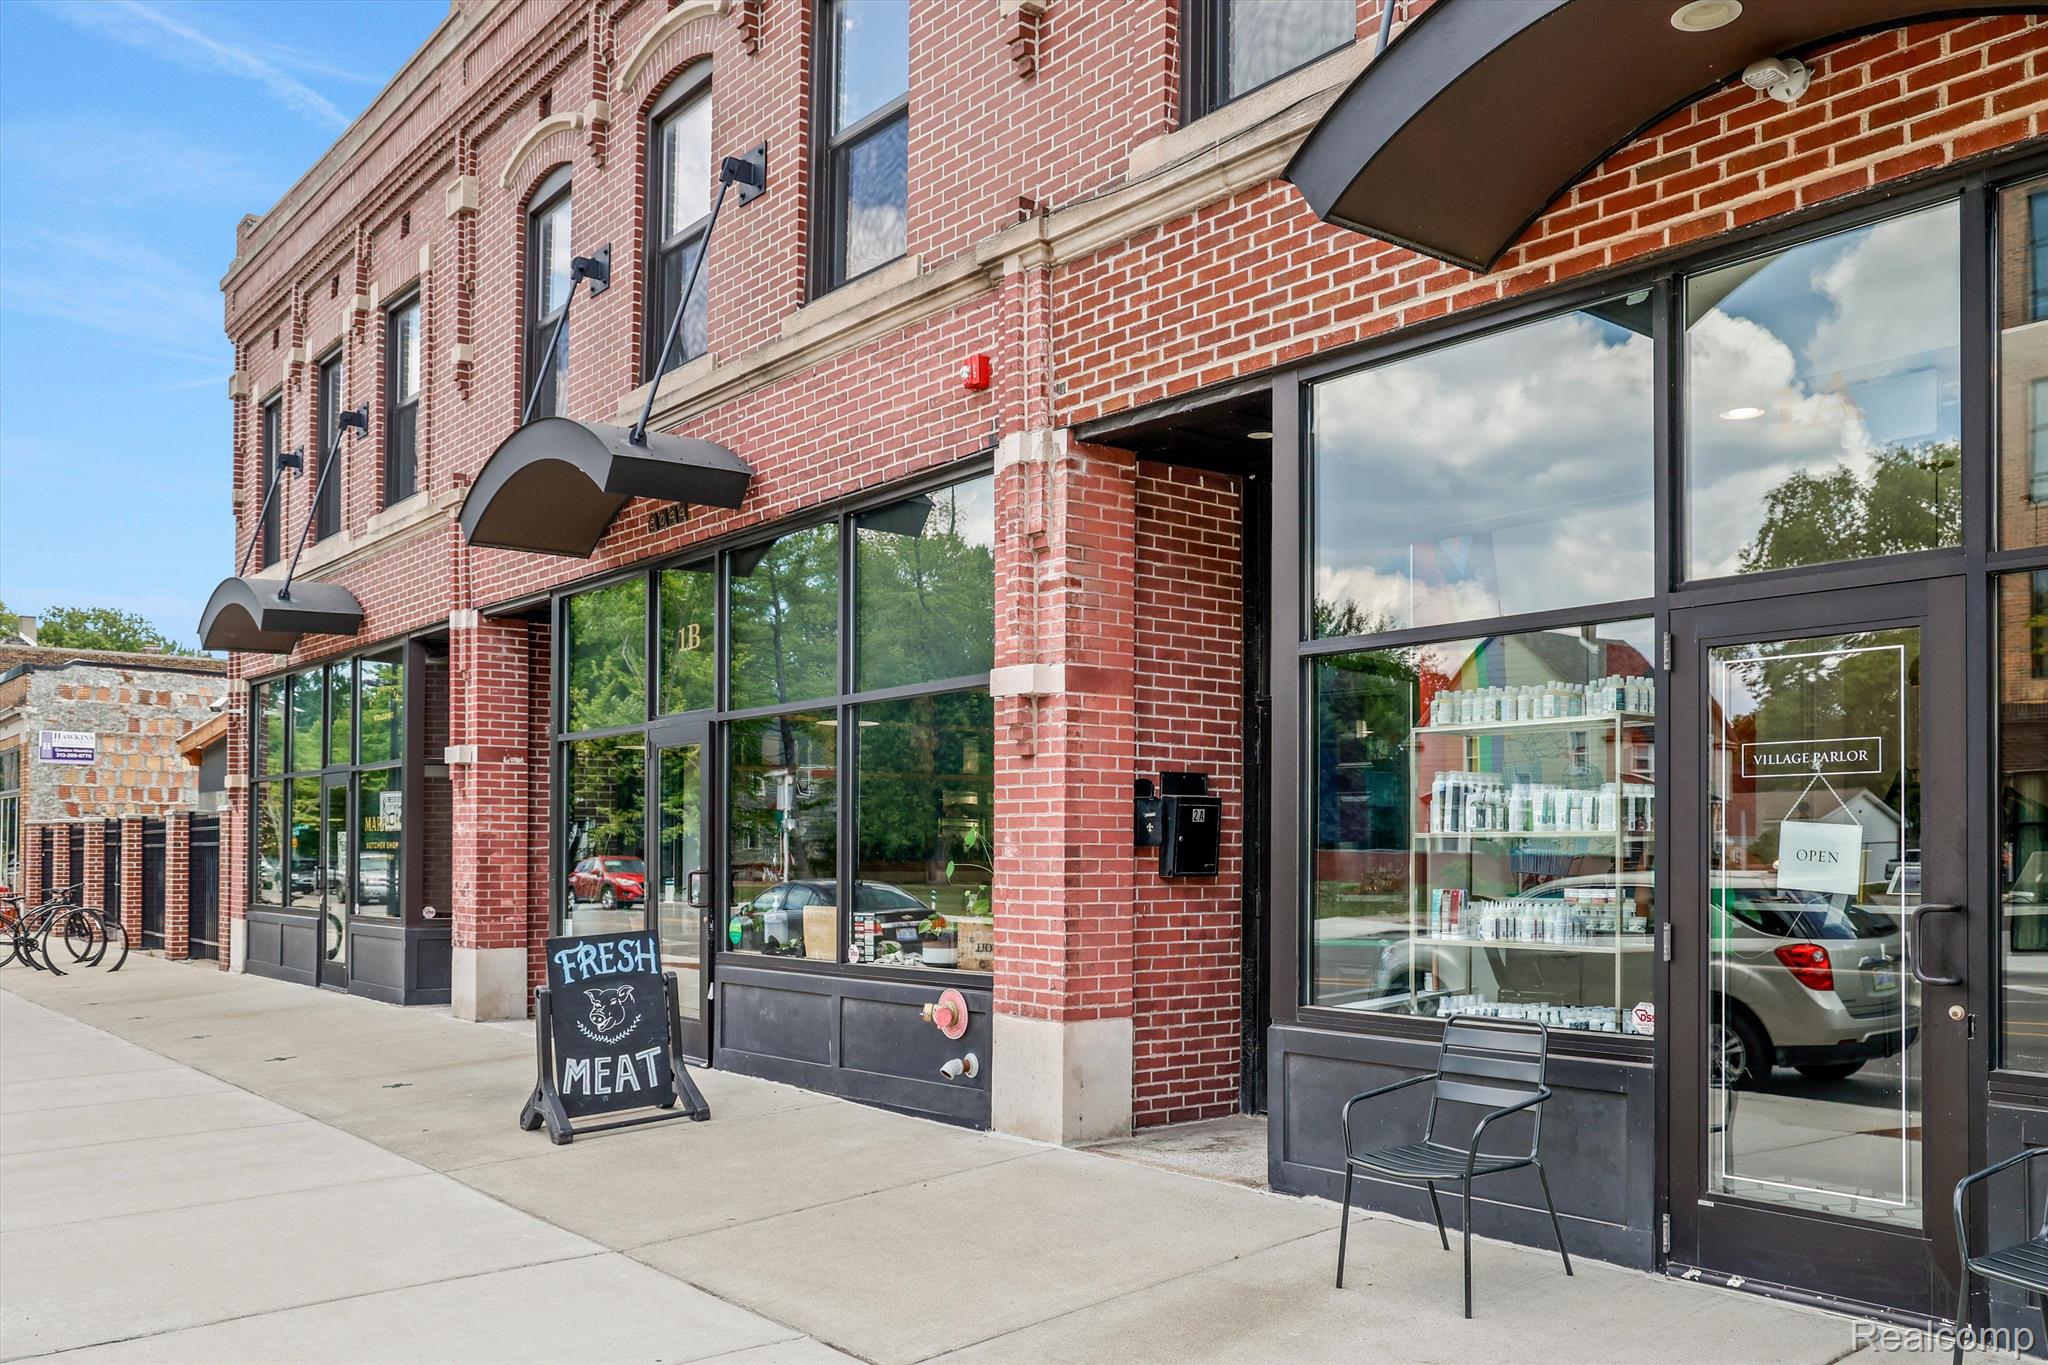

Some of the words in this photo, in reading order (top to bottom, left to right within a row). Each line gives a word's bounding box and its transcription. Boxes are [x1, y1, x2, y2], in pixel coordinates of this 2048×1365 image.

[679, 623, 701, 652] 1B
[54, 732, 94, 741] HAWKINS
[1753, 752, 1809, 765] VILLAGE
[1813, 750, 1868, 764] PARLOR
[1192, 809, 1205, 822] 2A
[366, 841, 386, 850] BUTCHER
[386, 841, 399, 849] SHOP
[1796, 848, 1839, 863] OPEN
[554, 937, 658, 985] FRESH
[562, 1046, 662, 1096] MEAT
